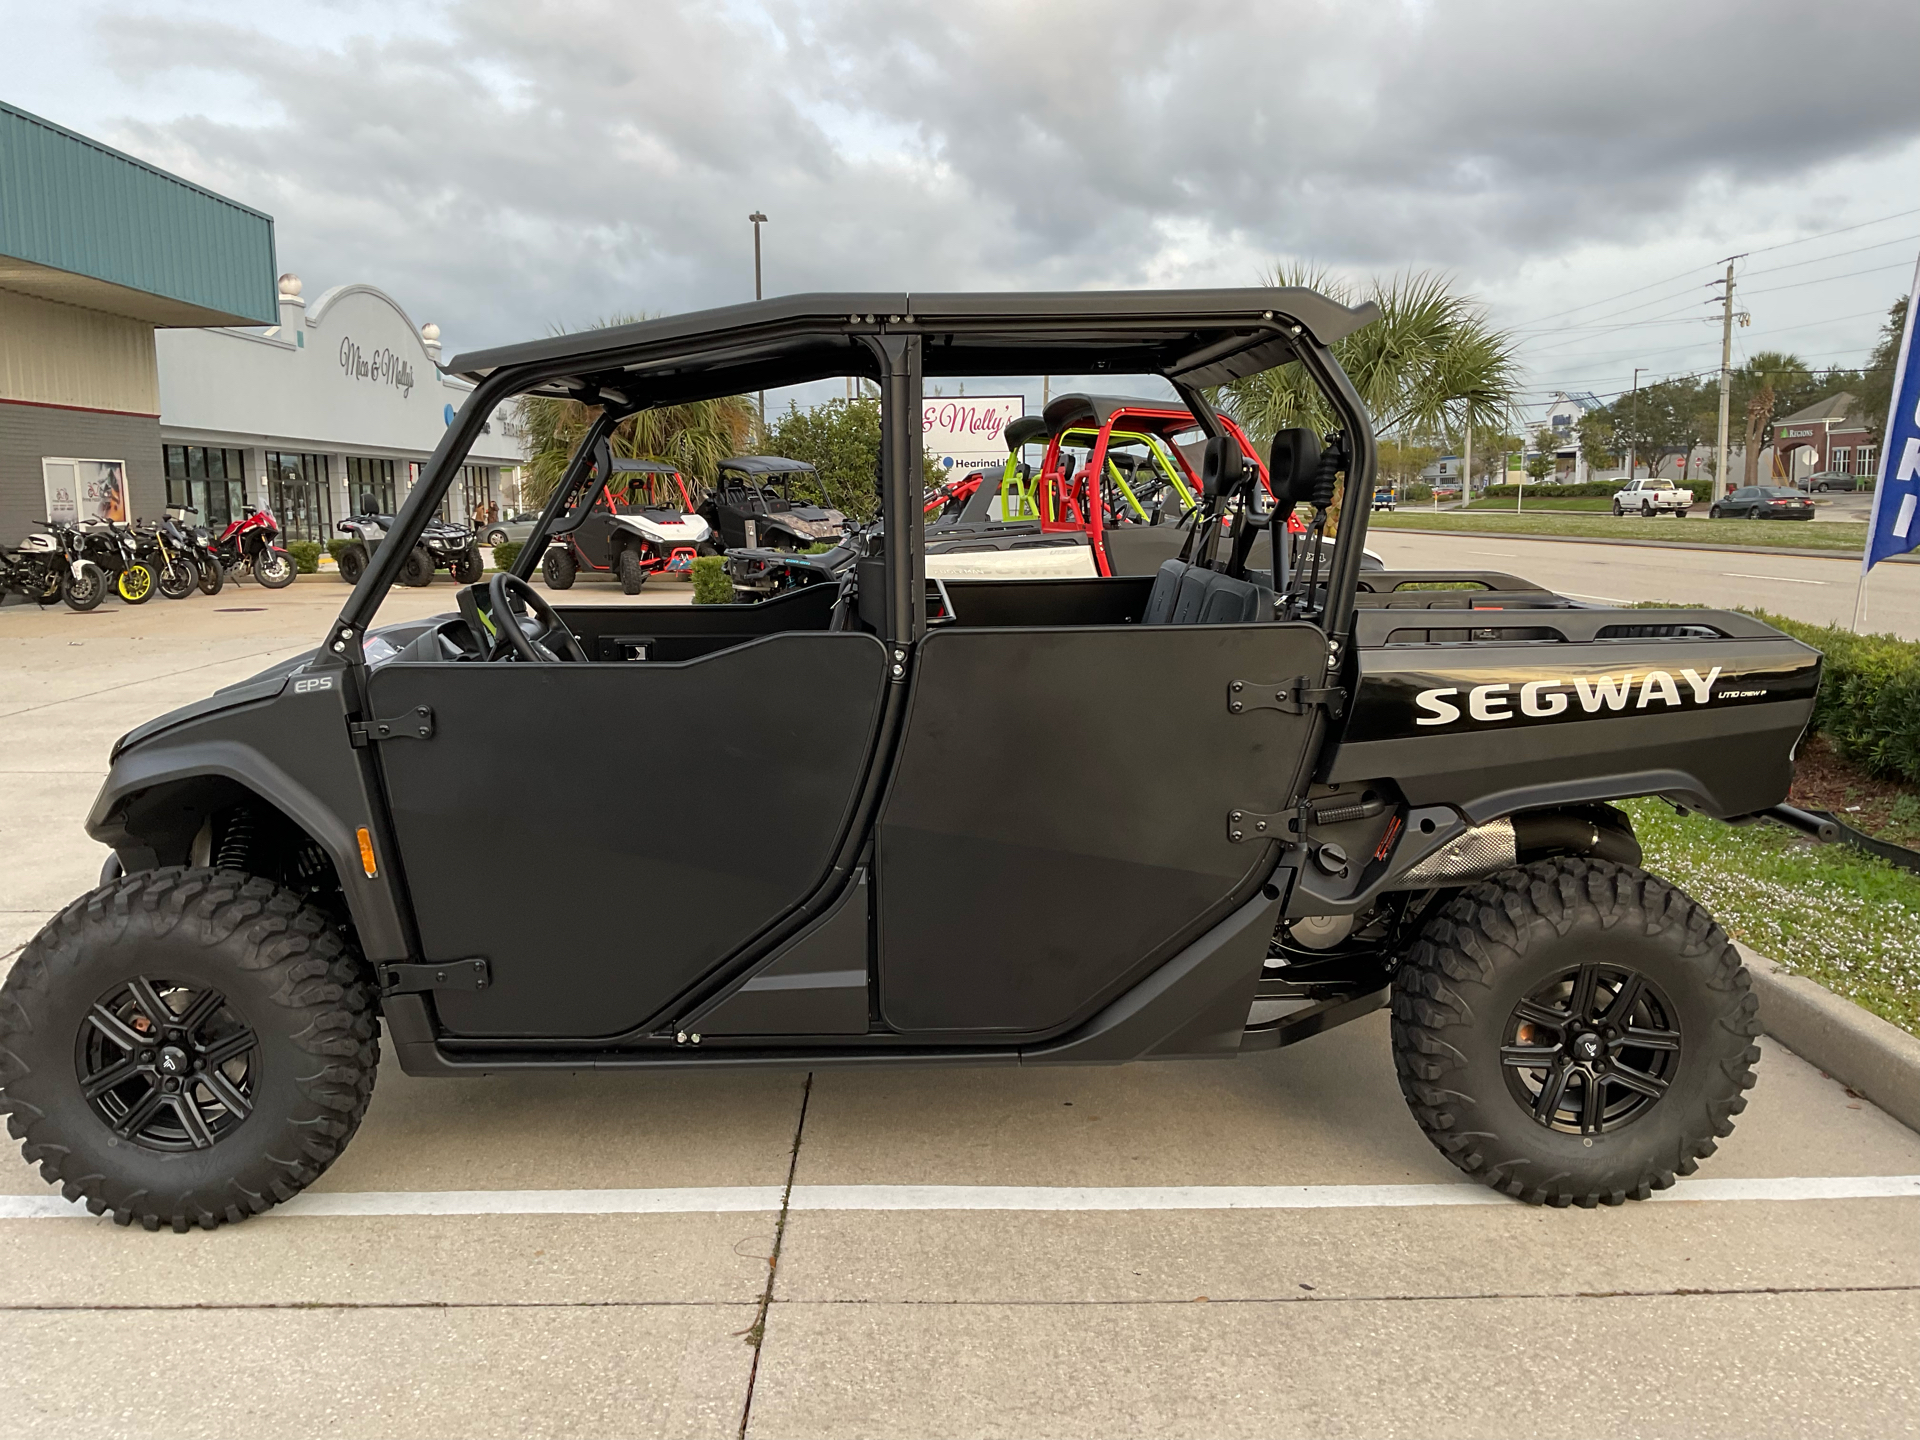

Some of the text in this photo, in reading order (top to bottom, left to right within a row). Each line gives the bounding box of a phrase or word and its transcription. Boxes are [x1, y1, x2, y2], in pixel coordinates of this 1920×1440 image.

[340, 336, 369, 381] Mica
[371, 349, 380, 381] &
[922, 403, 1012, 440] & Molly's
[1789, 429, 1814, 438] REGIONS
[955, 458, 1021, 468] HearingLi
[294, 676, 333, 693] EPS
[1415, 667, 1722, 725] SEGWAY
